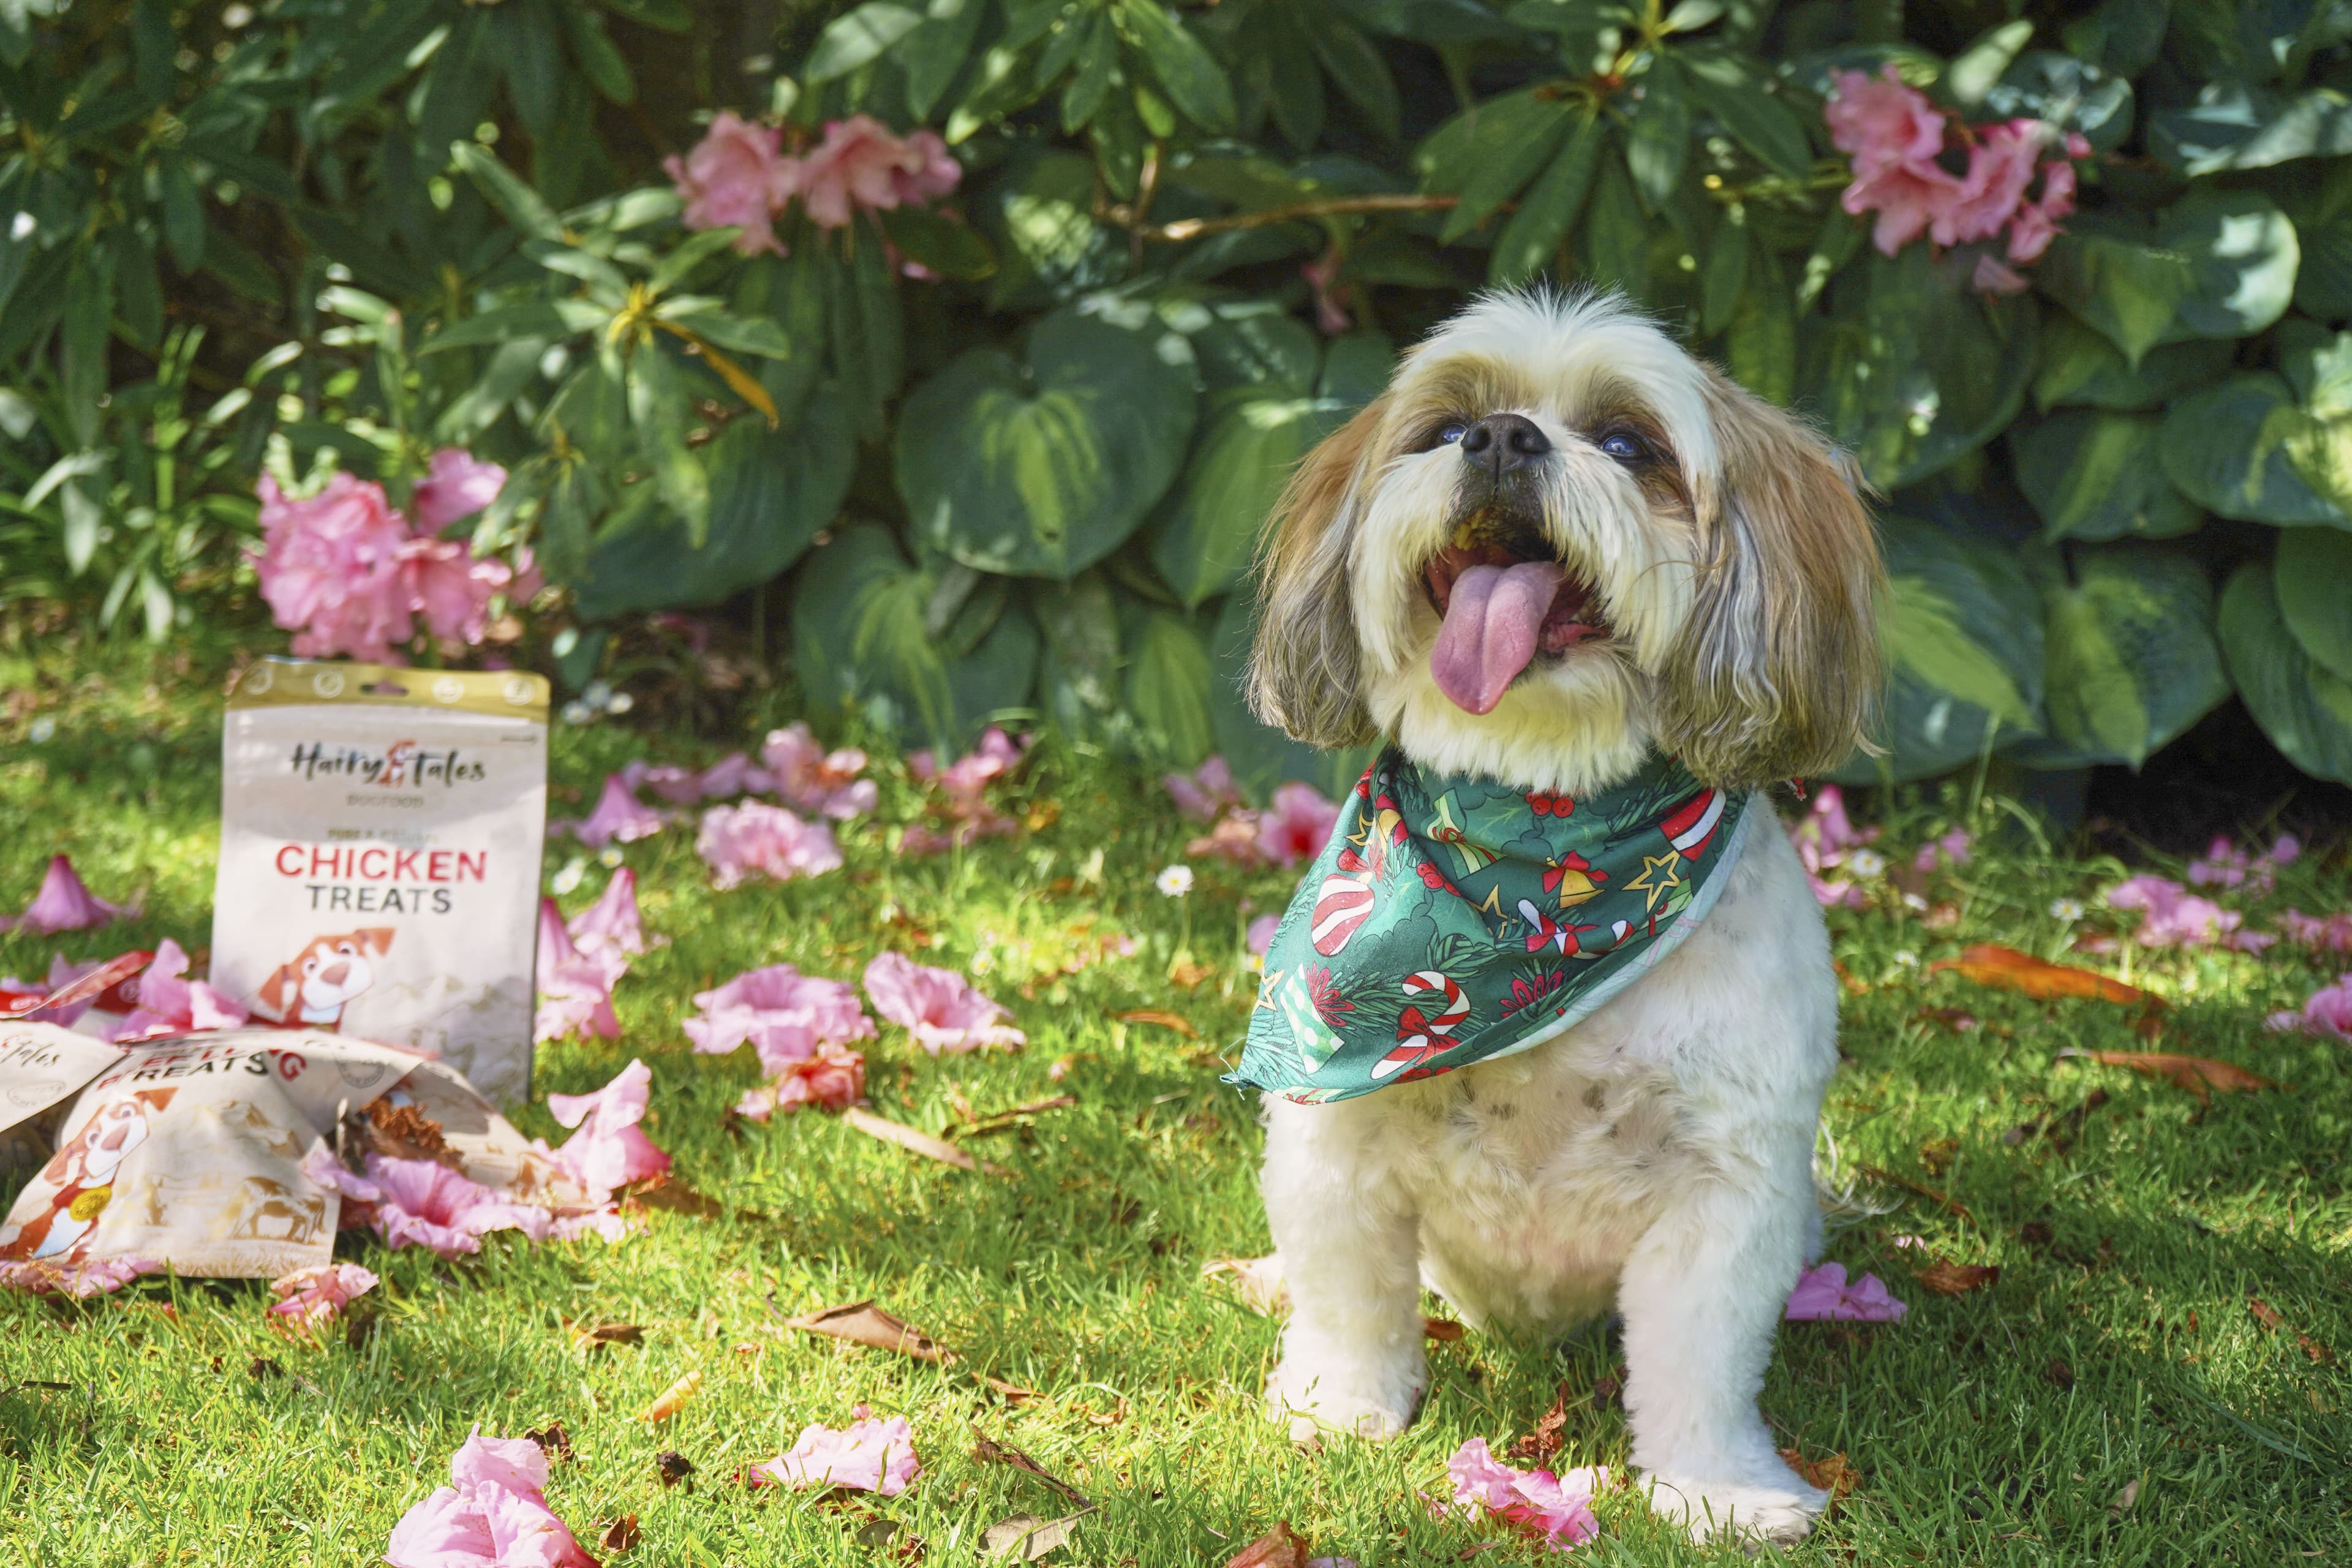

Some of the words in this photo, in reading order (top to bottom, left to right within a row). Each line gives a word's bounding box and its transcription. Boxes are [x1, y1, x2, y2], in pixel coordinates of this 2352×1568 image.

[291, 741, 384, 784] Hairy
[405, 748, 486, 788] Tales
[275, 845, 488, 882] CHICKEN
[305, 884, 452, 914] TREATS
